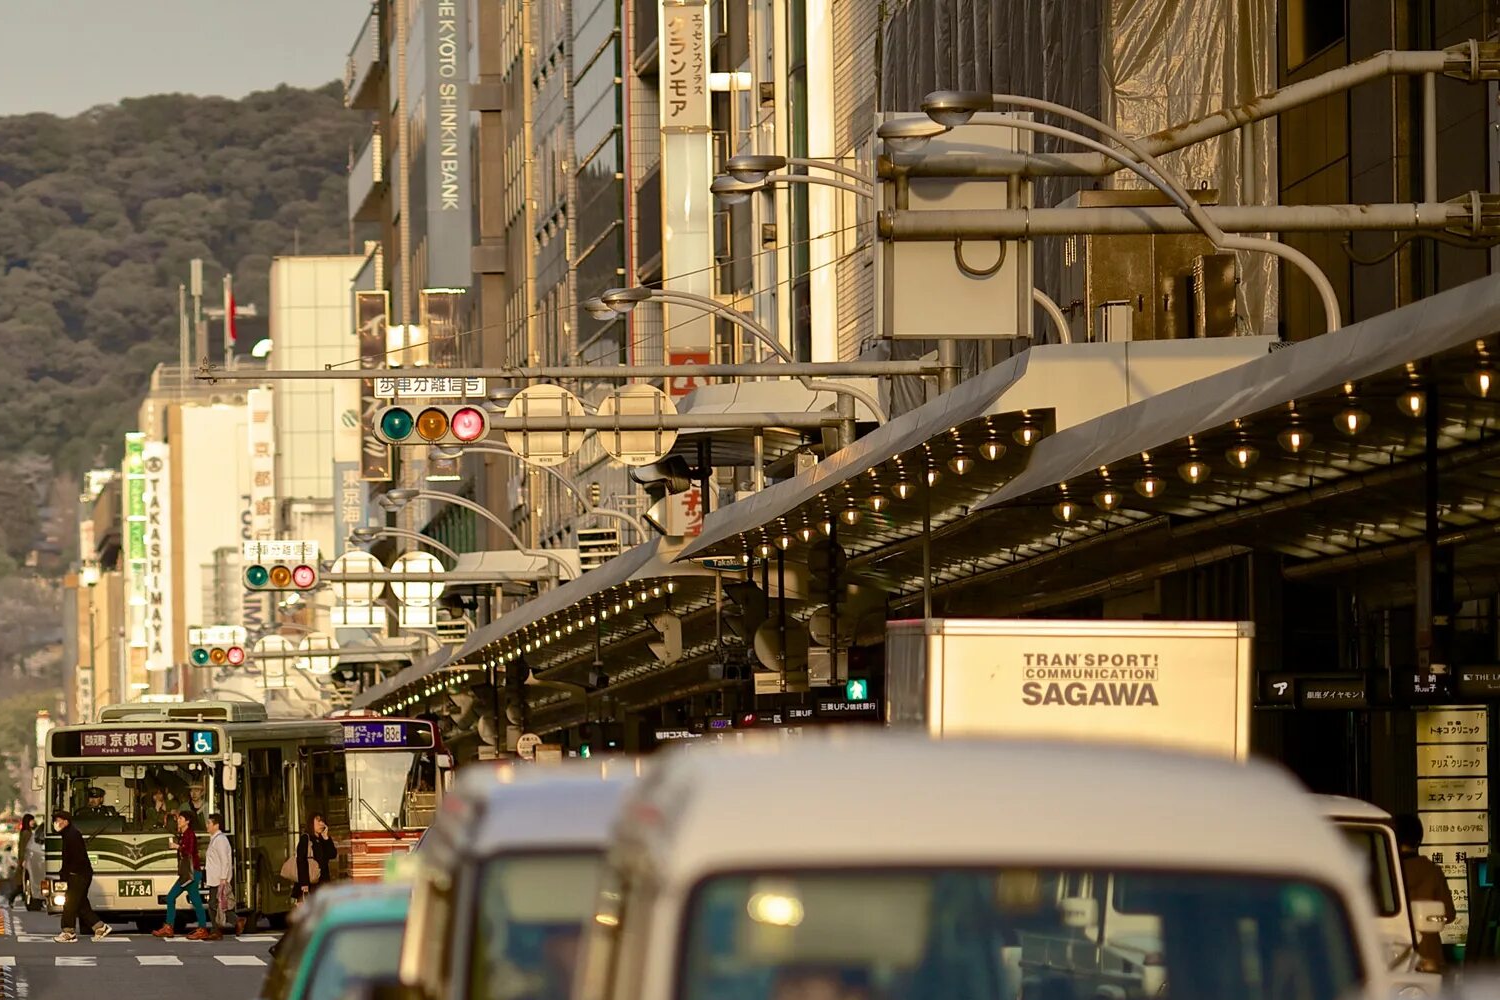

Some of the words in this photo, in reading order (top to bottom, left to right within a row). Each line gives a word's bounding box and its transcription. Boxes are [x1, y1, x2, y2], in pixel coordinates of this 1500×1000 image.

[438, 20, 457, 77] KYOTO
[439, 83, 457, 156] SHINKIN
[441, 159, 459, 210] BANK
[149, 479, 163, 654] TAKASHIMAYA
[1025, 668, 1155, 679] COMMUNICATION
[1022, 681, 1159, 706] SAGAWA
[110, 733, 153, 747] 京都駅
[161, 733, 182, 750] 5
[1428, 793, 1482, 801] エステアップ
